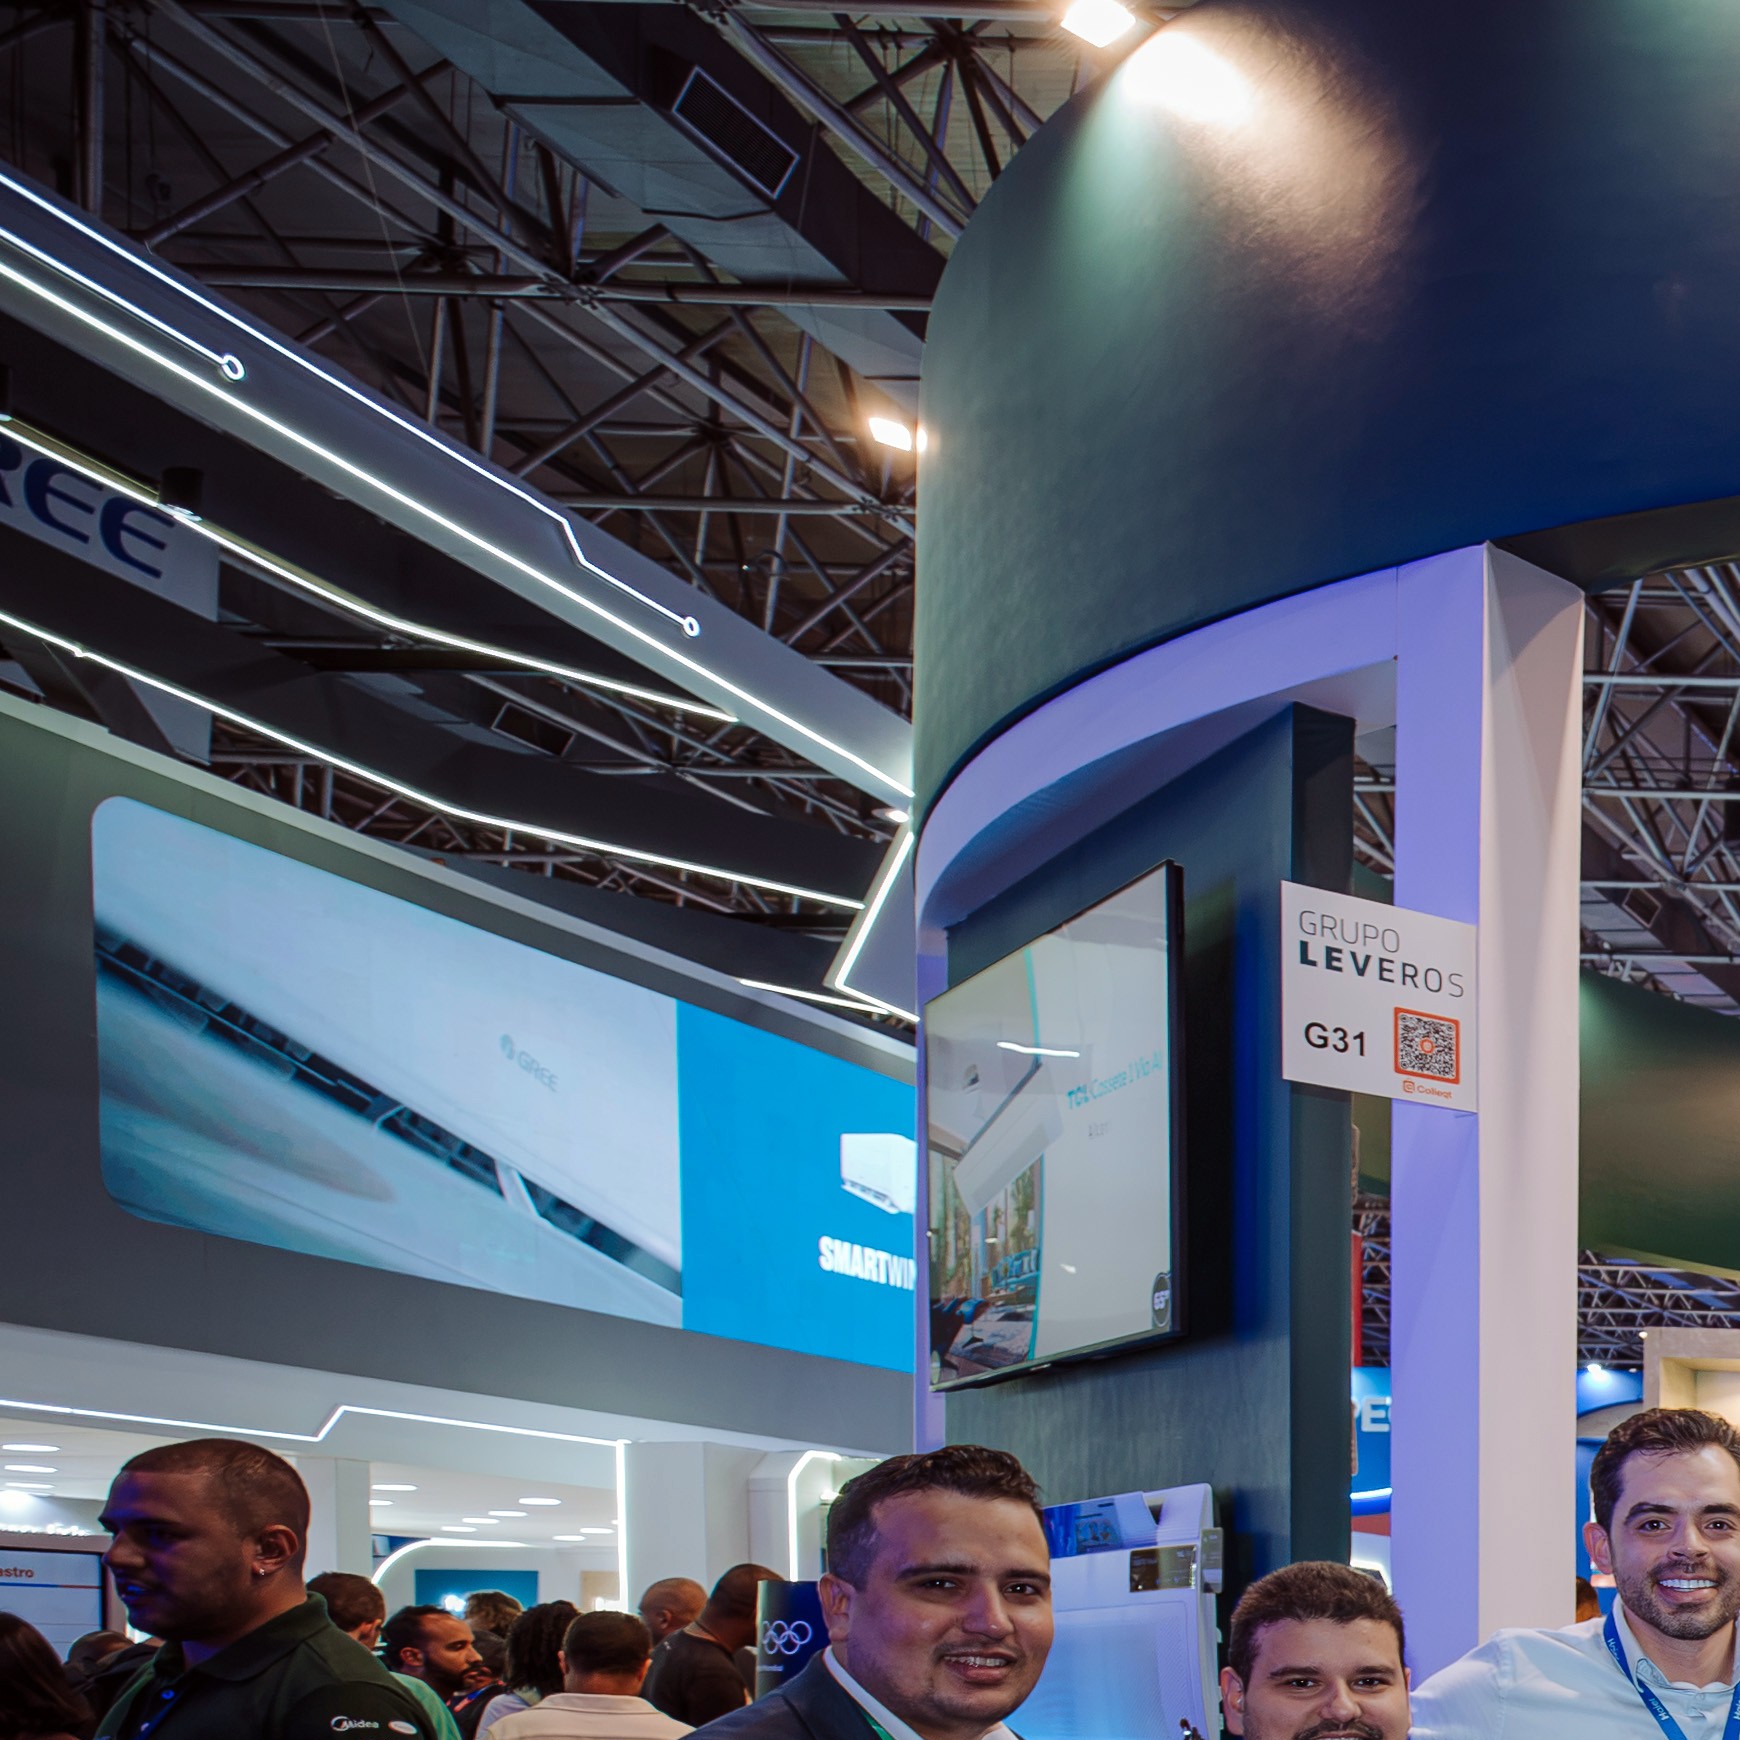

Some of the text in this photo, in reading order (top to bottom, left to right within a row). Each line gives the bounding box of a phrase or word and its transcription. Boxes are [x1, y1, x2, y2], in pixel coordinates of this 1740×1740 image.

[1300, 910, 1400, 953] GRUPO
[1299, 939, 1464, 998] LEVEROS
[1304, 1022, 1366, 1057] G31
[1649, 1698, 1669, 1721] Haier
